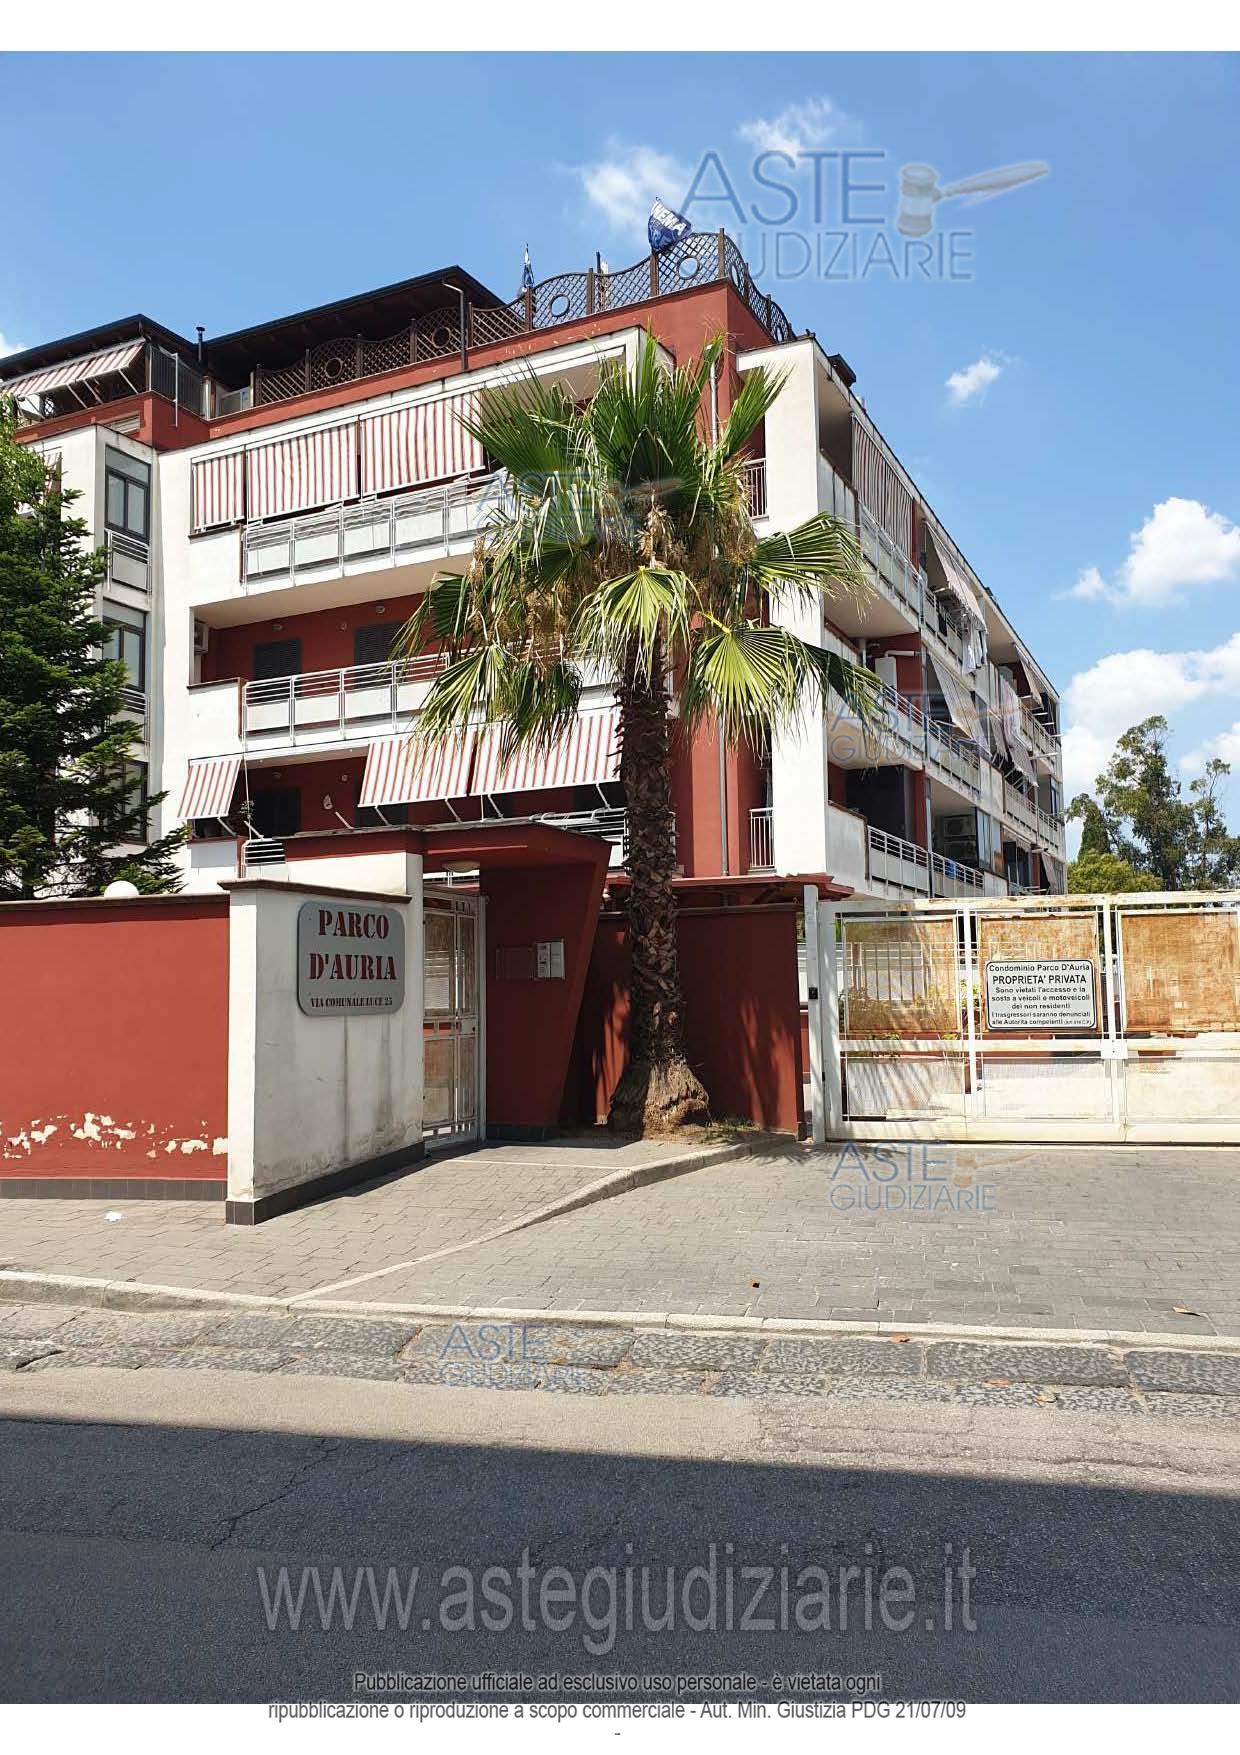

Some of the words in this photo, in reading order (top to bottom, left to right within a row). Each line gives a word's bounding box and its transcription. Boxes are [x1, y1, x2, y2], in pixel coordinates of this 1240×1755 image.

[318, 910, 389, 939] PARCO
[309, 953, 397, 980] D'AURIA
[992, 975, 1046, 985] PROPRIETA'
[1048, 974, 1087, 984] PRIVATA
[311, 998, 324, 1007] VIA
